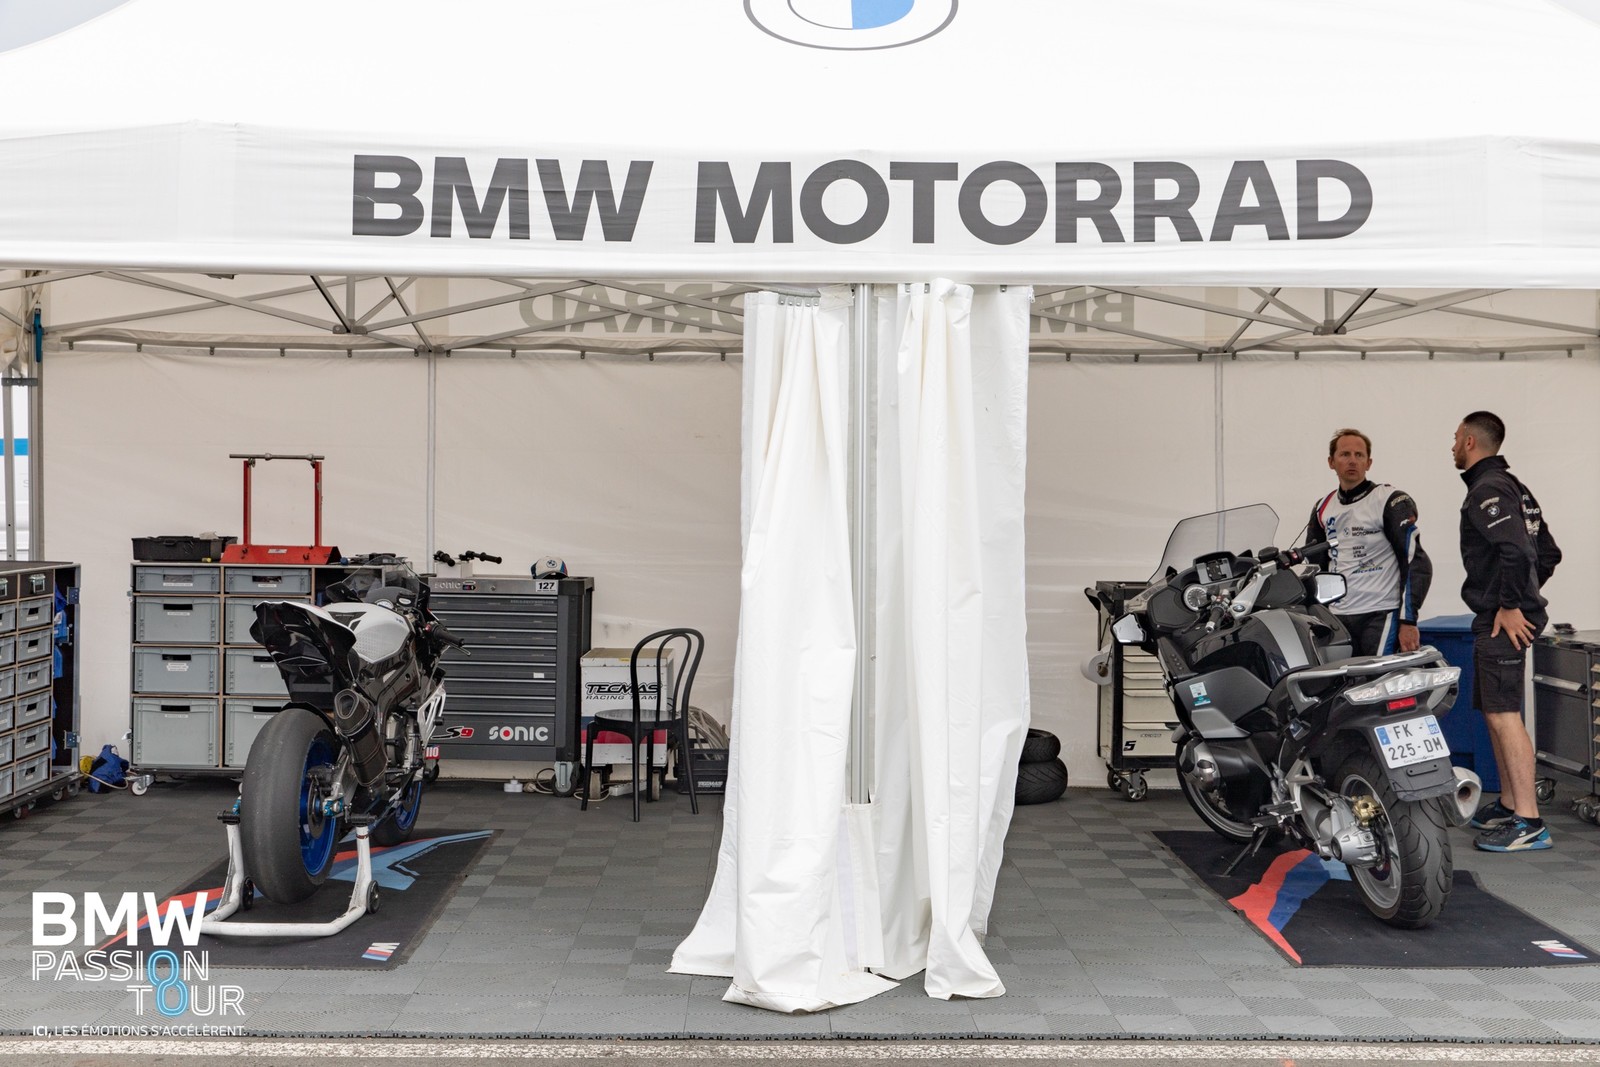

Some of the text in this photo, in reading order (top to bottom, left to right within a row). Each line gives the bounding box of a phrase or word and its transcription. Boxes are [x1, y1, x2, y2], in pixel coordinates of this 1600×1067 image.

[353, 155, 1372, 245] BMW MOTORRAD
[585, 682, 662, 695] TECMAS
[431, 726, 474, 740] S9
[1393, 723, 1413, 739] FK
[426, 747, 439, 757] 110
[1388, 737, 1443, 761] 225-DM
